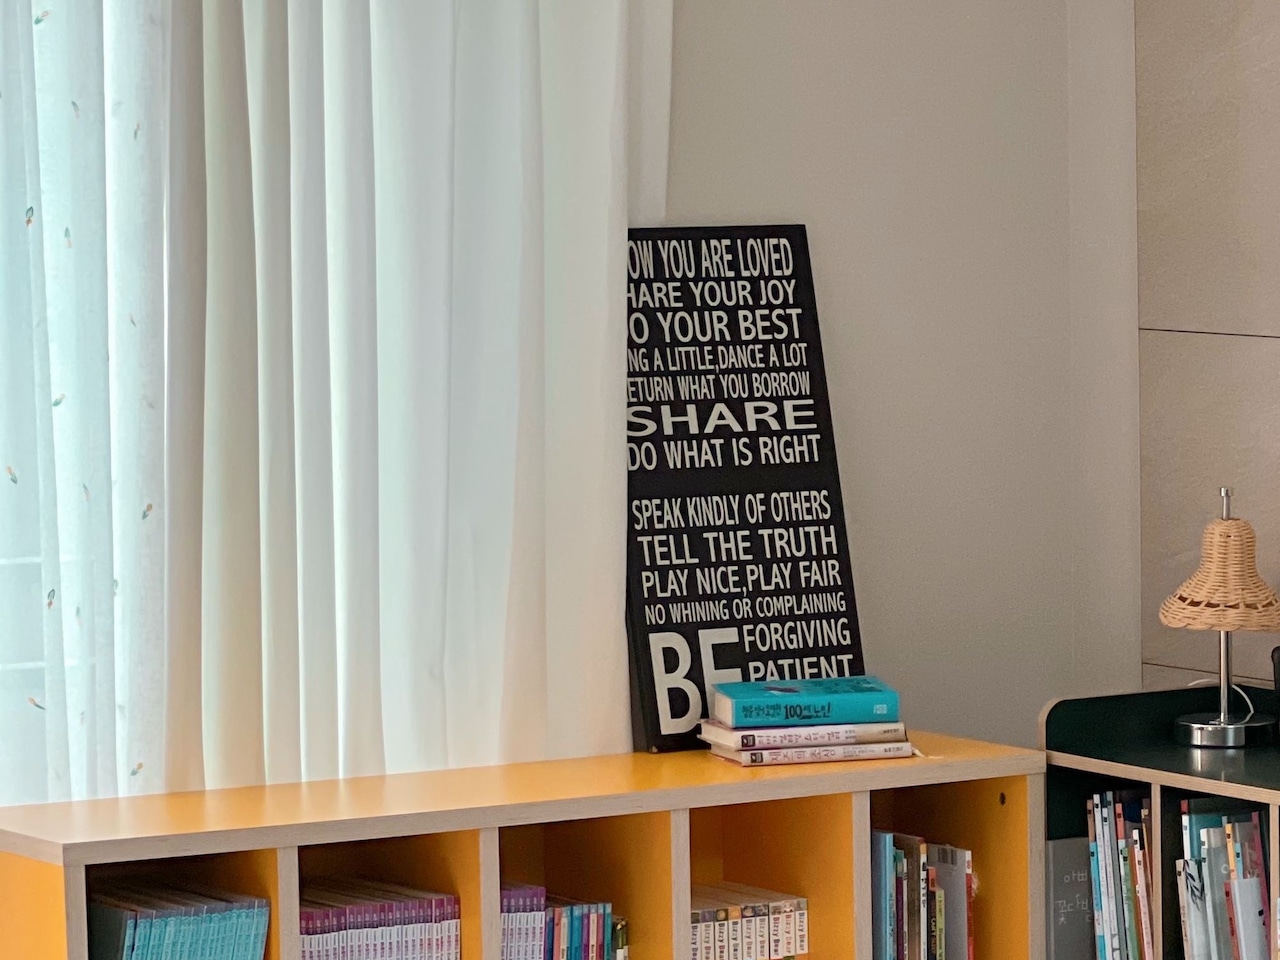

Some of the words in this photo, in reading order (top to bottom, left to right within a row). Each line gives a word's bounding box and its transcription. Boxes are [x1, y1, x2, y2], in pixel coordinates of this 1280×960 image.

[657, 240, 695, 278] YOU
[701, 239, 735, 277] ARE
[737, 238, 793, 277] LOVED
[688, 281, 753, 306] YOUR
[759, 279, 796, 305] JOY
[656, 310, 731, 343] YOUR
[738, 308, 802, 341] BEST
[653, 347, 664, 371] A
[769, 344, 779, 367] A
[782, 343, 807, 367] LOT
[627, 376, 673, 403] ETURN
[677, 375, 715, 400] WHAT
[719, 374, 749, 399] YOU
[752, 371, 810, 397] BORROW
[627, 399, 817, 437] SHARE
[628, 442, 657, 471] DO
[663, 439, 724, 469] WHAT
[732, 437, 753, 466] IS
[758, 434, 821, 465] RIGHT
[632, 497, 684, 530] SPEAK
[686, 494, 739, 527] KINDLY
[745, 493, 766, 524] OF
[770, 490, 831, 522] OTHERS
[637, 533, 699, 566] TELL
[703, 530, 753, 562] THE
[758, 525, 838, 559] TRUTH
[641, 569, 689, 598] PLAY
[799, 559, 842, 588] FAIR
[644, 604, 666, 625] NO
[669, 600, 729, 623] WHINING
[732, 598, 753, 620] OR
[755, 591, 847, 617] COMPLAINING
[743, 617, 851, 653] FORGIVING
[649, 627, 743, 735] BE
[748, 654, 854, 683] PATIENT
